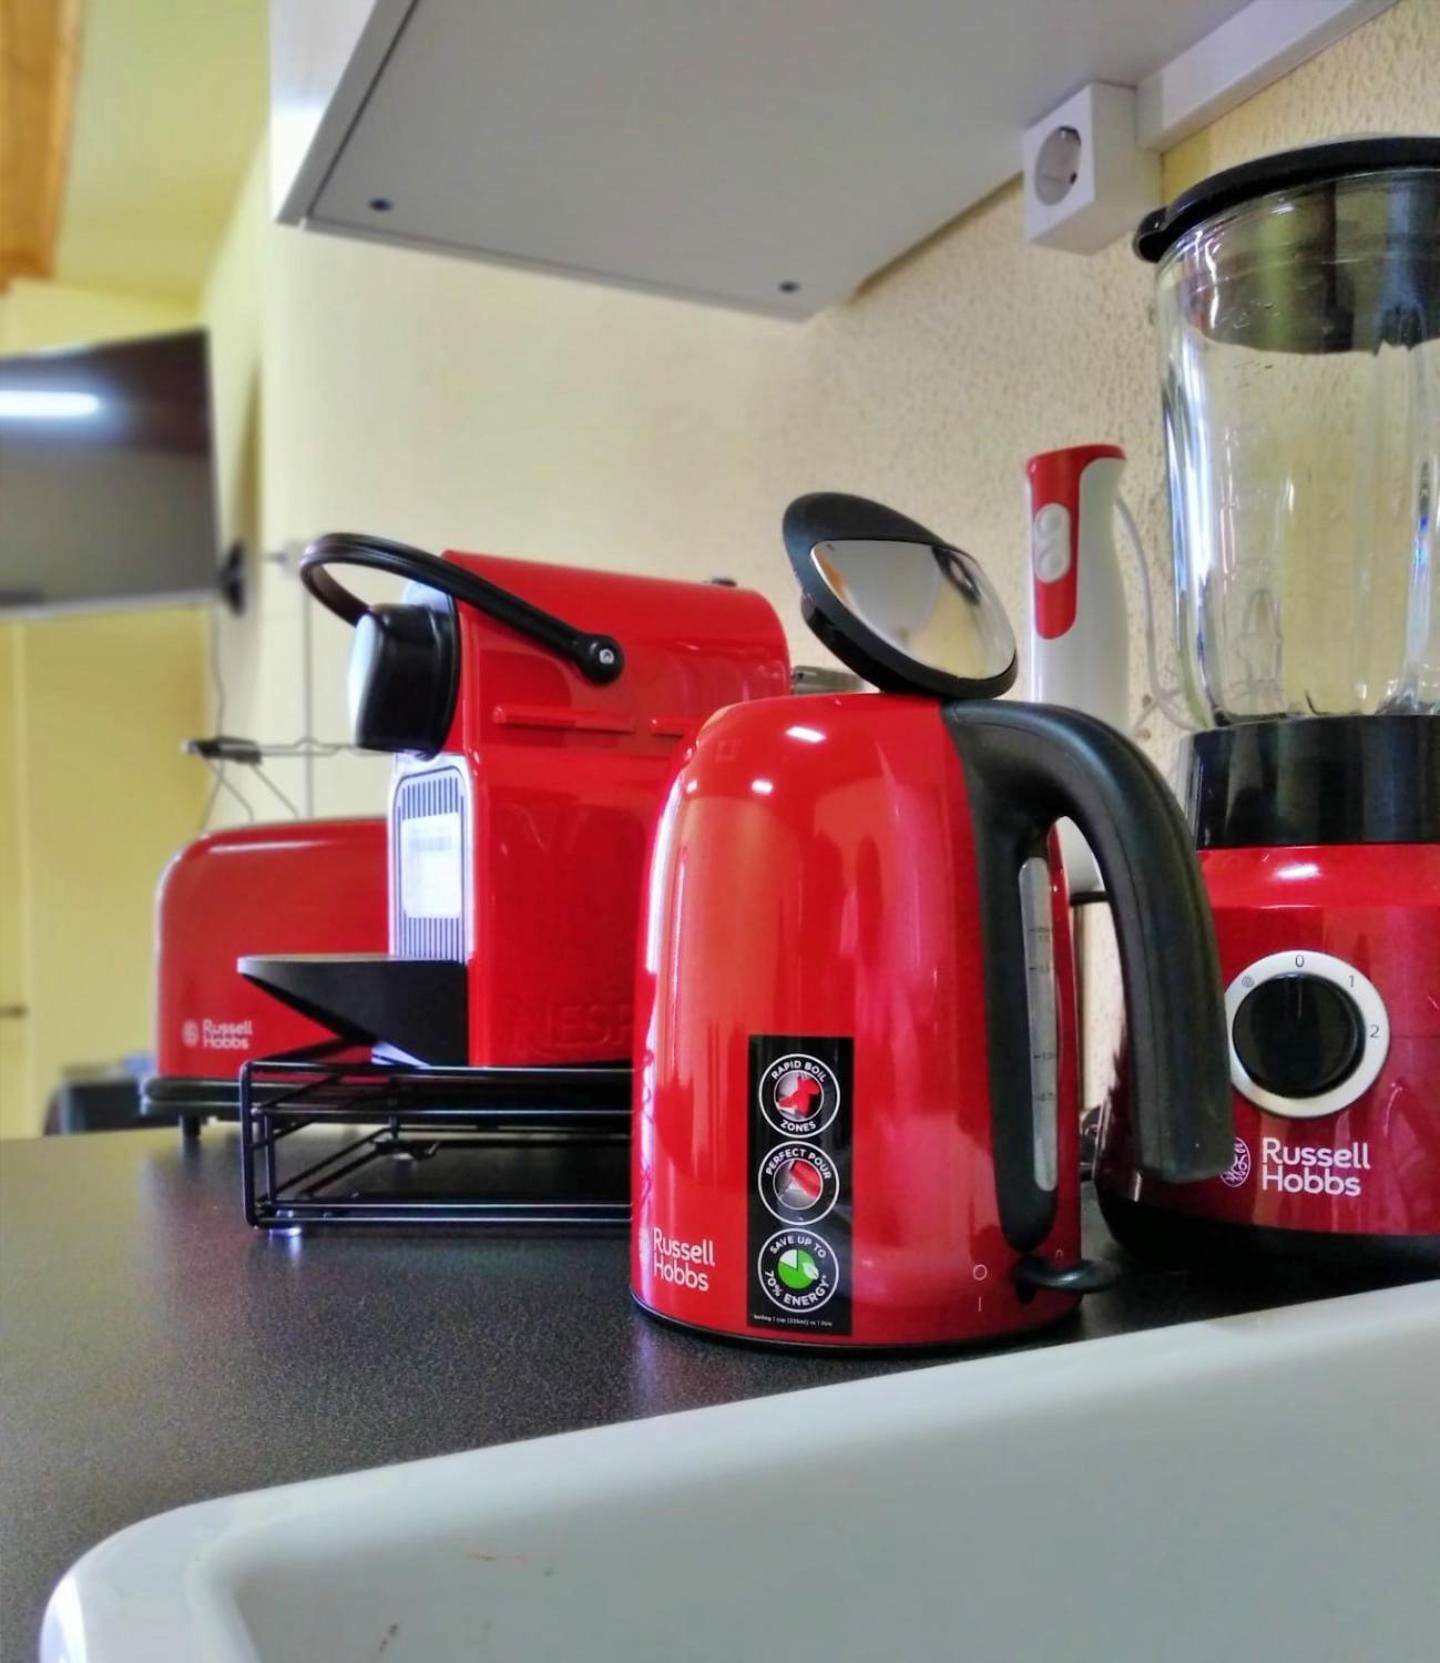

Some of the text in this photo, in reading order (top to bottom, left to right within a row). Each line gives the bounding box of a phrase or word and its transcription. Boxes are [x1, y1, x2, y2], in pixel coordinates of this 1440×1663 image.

[203, 1018, 254, 1035] Russell
[1368, 1023, 1381, 1039] 2
[203, 1033, 249, 1050] Hobbs
[771, 1060, 827, 1082] RAPID BOIL
[780, 1119, 816, 1132] ZONES
[765, 1148, 832, 1179] PERFECT POUR
[1261, 1136, 1371, 1169] Russell
[1261, 1164, 1361, 1197] Hobbs
[653, 1226, 716, 1267] Russell
[769, 1235, 827, 1258] SAVE UP TO
[653, 1252, 709, 1292] Hobbs
[765, 1269, 782, 1297] 70%
